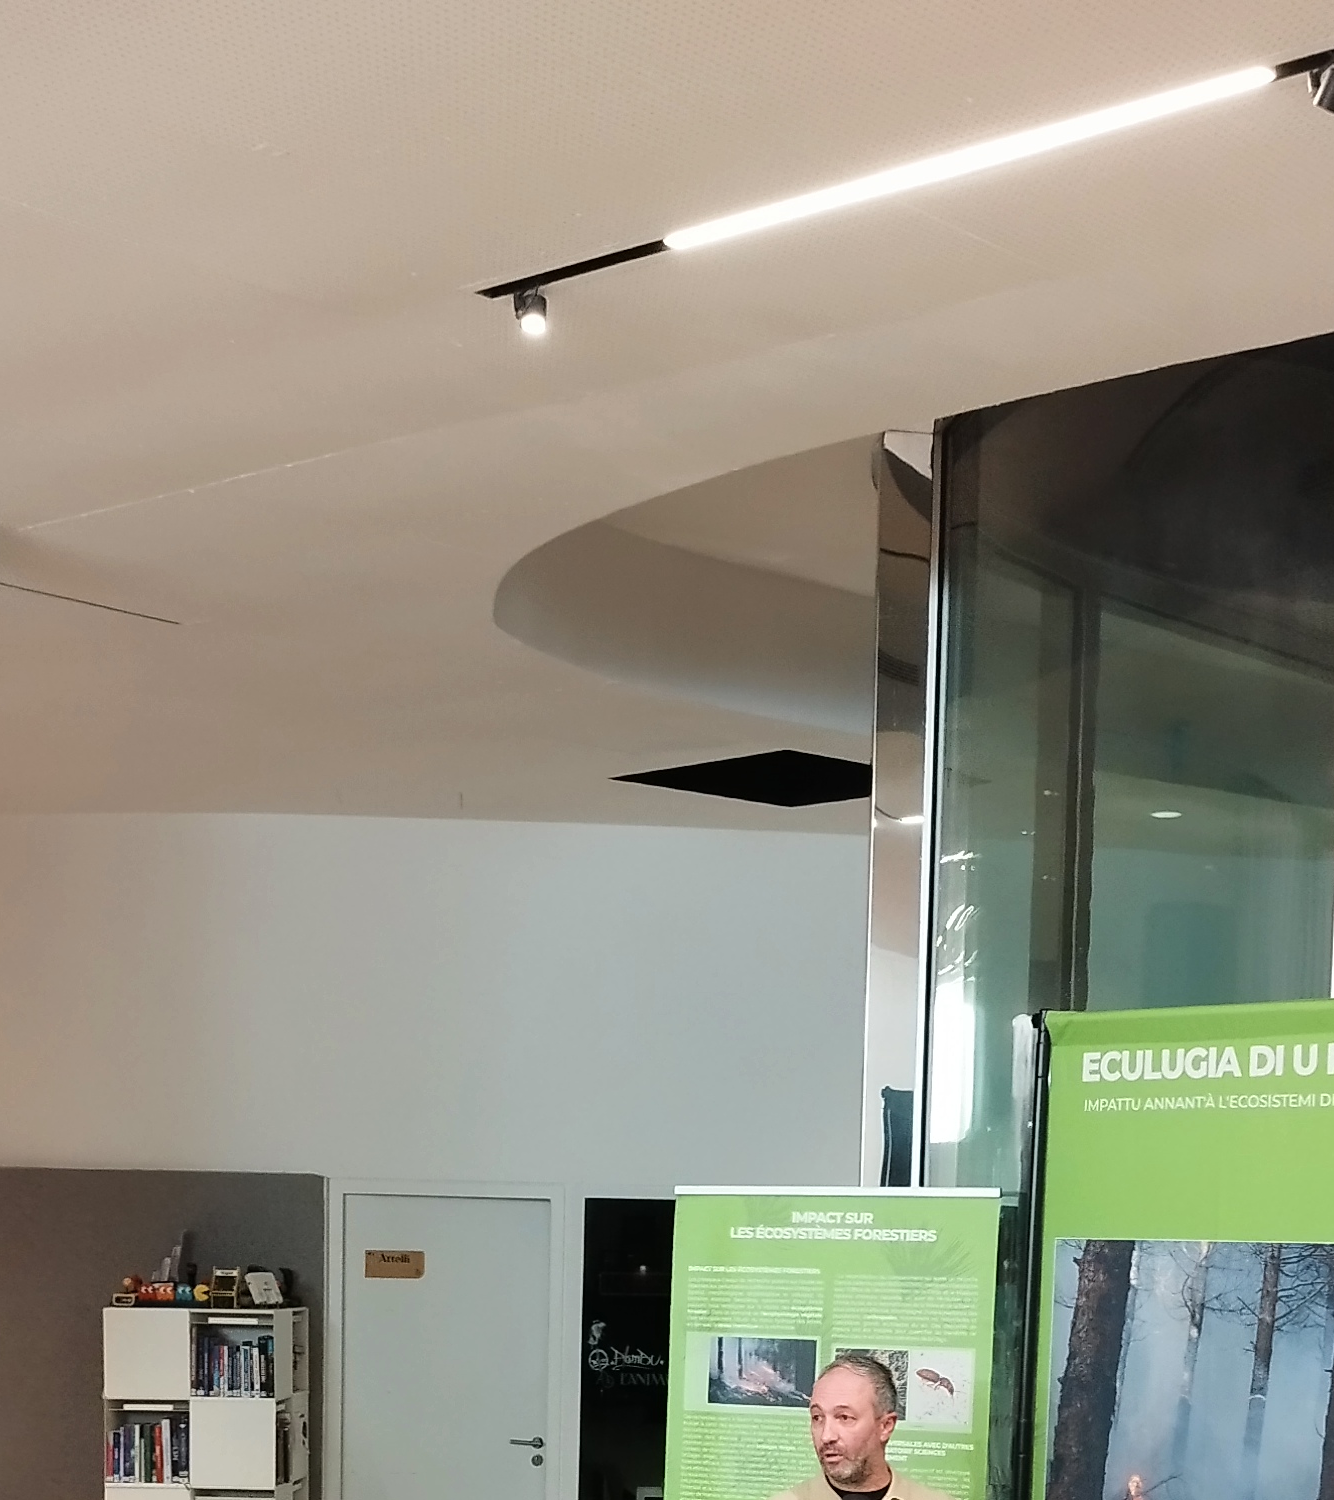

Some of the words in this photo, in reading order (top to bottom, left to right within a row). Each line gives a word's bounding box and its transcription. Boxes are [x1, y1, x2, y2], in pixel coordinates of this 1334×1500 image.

[1082, 1046, 1242, 1082] ECULUGIA
[1249, 1045, 1284, 1077] DI
[1293, 1044, 1318, 1076] U
[1084, 1098, 1140, 1112] IMPATTU
[1219, 1093, 1315, 1109] L'ECOSISTEMI
[791, 1211, 844, 1224] IMPACT
[845, 1212, 874, 1225] SUR
[730, 1226, 754, 1239] LES
[756, 1224, 851, 1240] ÉCOSYSTÈMES
[853, 1228, 937, 1242] FORESTIERS
